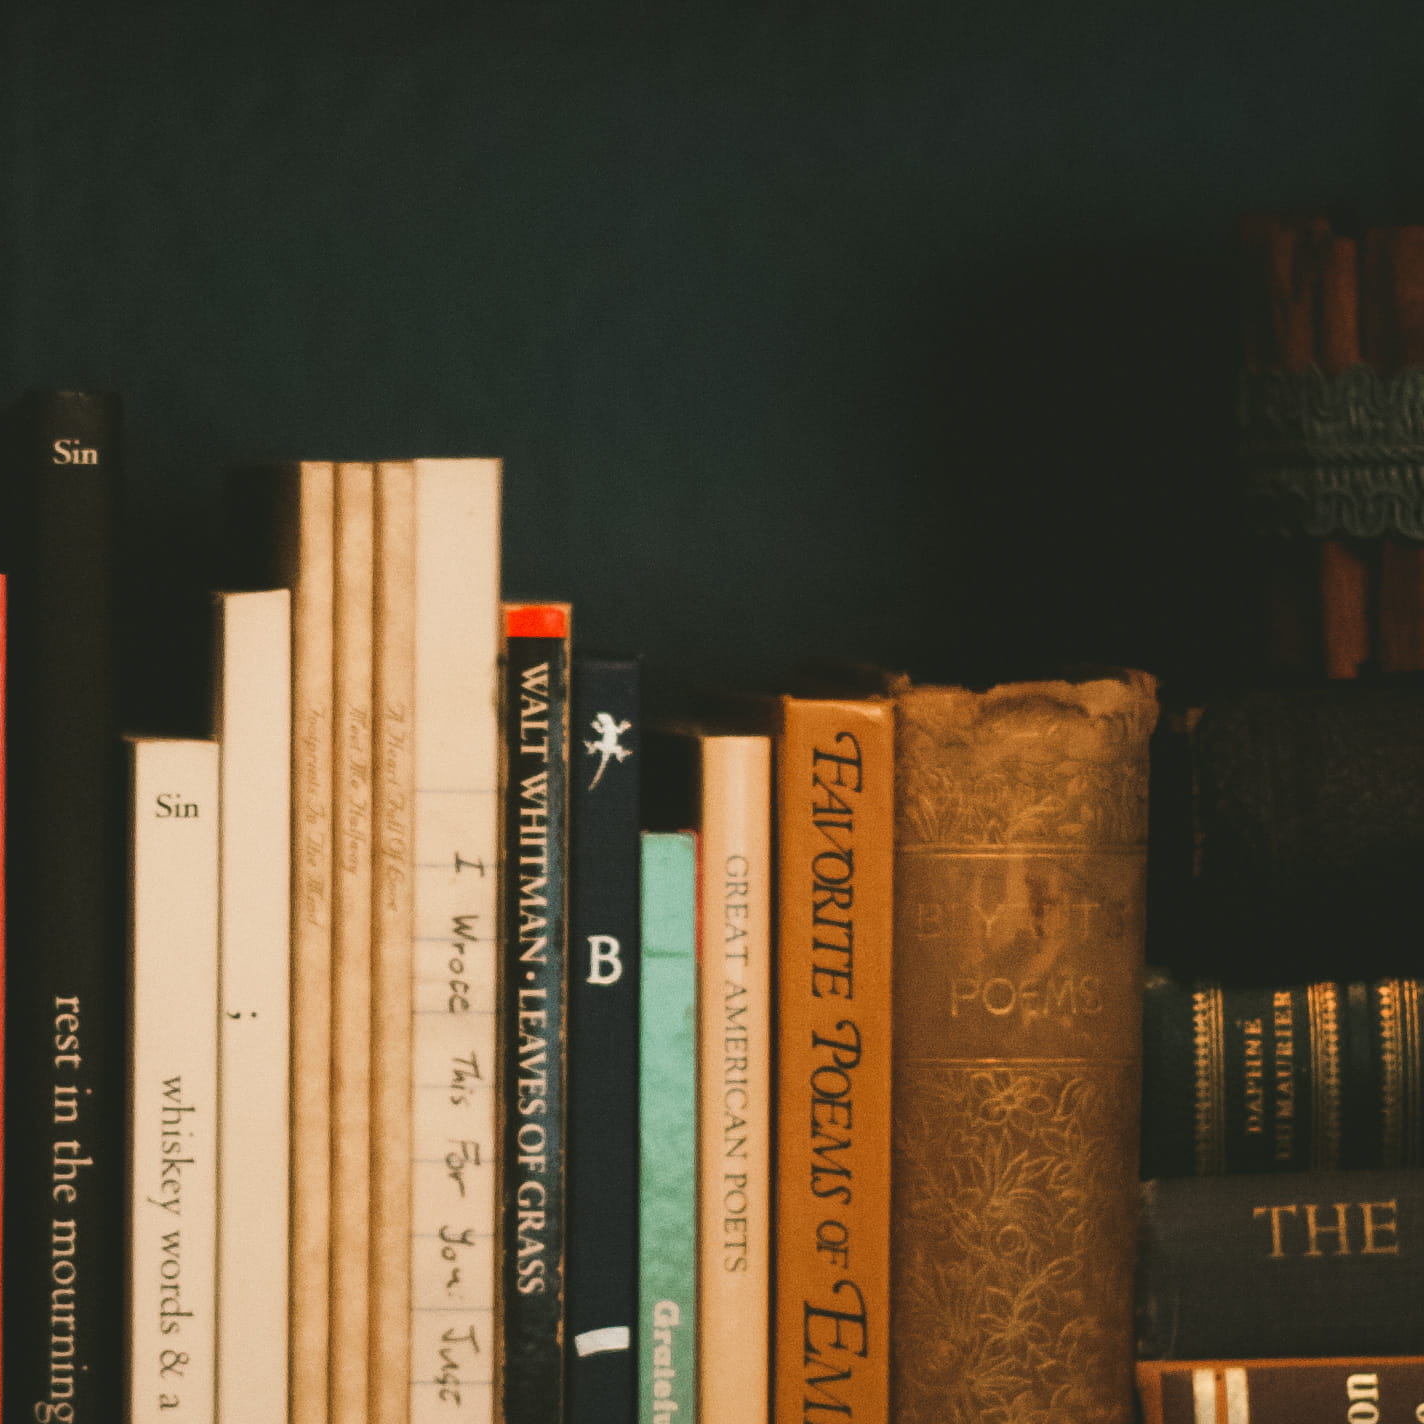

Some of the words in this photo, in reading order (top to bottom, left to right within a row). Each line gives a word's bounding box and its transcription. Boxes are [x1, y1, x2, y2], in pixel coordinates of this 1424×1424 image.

[51, 439, 99, 466] Sin
[519, 662, 548, 763] WALT
[154, 793, 201, 819] Sin
[453, 851, 485, 879] I
[518, 770, 549, 964] WHITMAN
[810, 731, 863, 1001] FAVORITE
[723, 853, 751, 968] GREAT
[445, 912, 480, 1015] Wrote
[586, 935, 623, 985] B
[52, 995, 83, 1070] rest
[517, 988, 548, 1116] LEAVES
[51, 1084, 93, 1124] in
[448, 1051, 483, 1107] This
[723, 980, 751, 1161] AMERICAN
[146, 1075, 197, 1217] whiskey
[518, 1123, 548, 1173] OF
[810, 1019, 863, 1206] POEMS
[51, 1140, 94, 1204] the
[444, 1138, 481, 1198] For
[516, 1180, 546, 1297] GRASS
[723, 1171, 749, 1273] POETS
[815, 1220, 851, 1271] OF
[1251, 1200, 1401, 1260] THE
[157, 1230, 194, 1336] words
[158, 1347, 190, 1380] &
[434, 1325, 478, 1408] Just
[157, 1393, 183, 1411] a
